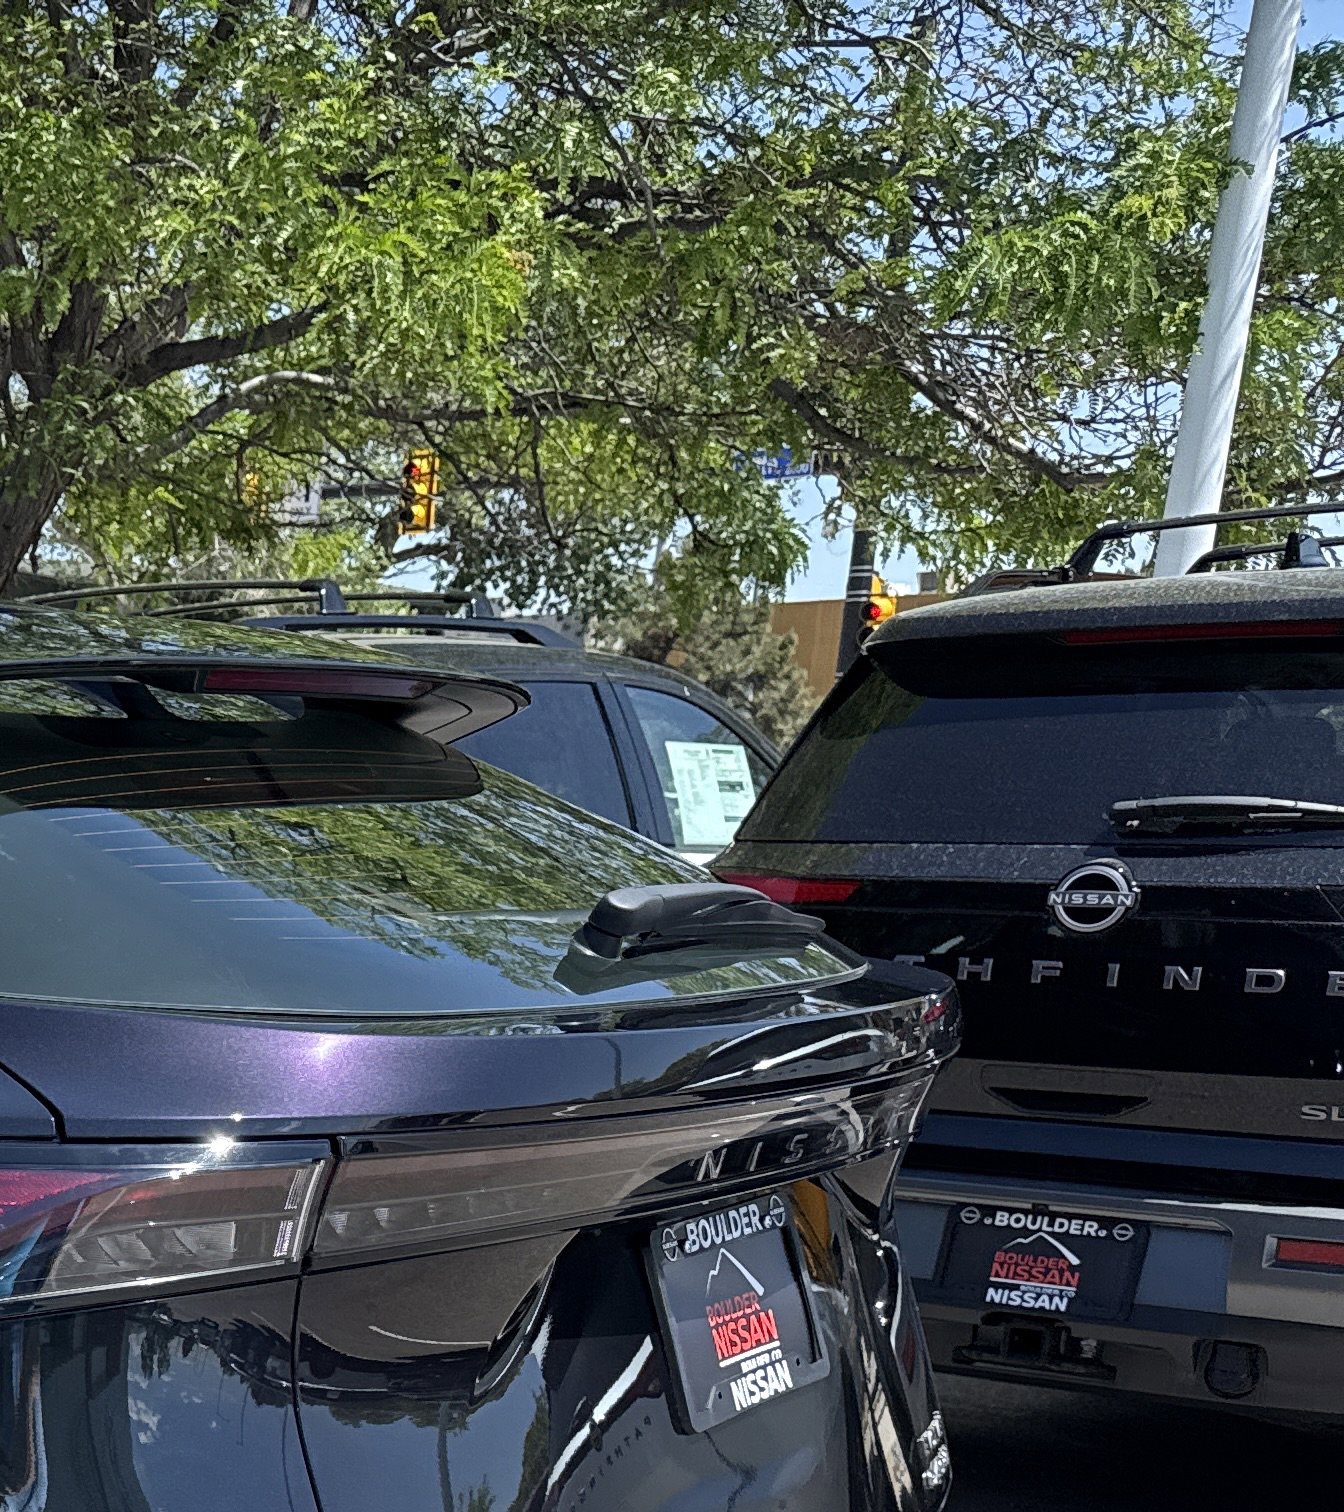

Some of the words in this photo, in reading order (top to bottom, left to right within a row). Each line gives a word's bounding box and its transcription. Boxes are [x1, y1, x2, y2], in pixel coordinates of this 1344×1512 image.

[1049, 892, 1134, 907] NISSAN
[686, 1203, 764, 1253] BOULDER
[994, 1210, 1100, 1237] BOULDER
[993, 1250, 1070, 1269] BOULDER
[990, 1262, 1080, 1287] NISSAN
[705, 1292, 761, 1328] BOULDER
[985, 1287, 1069, 1311] NISSAN
[711, 1308, 779, 1361] NISSAN
[730, 1359, 794, 1412] NISSAN
